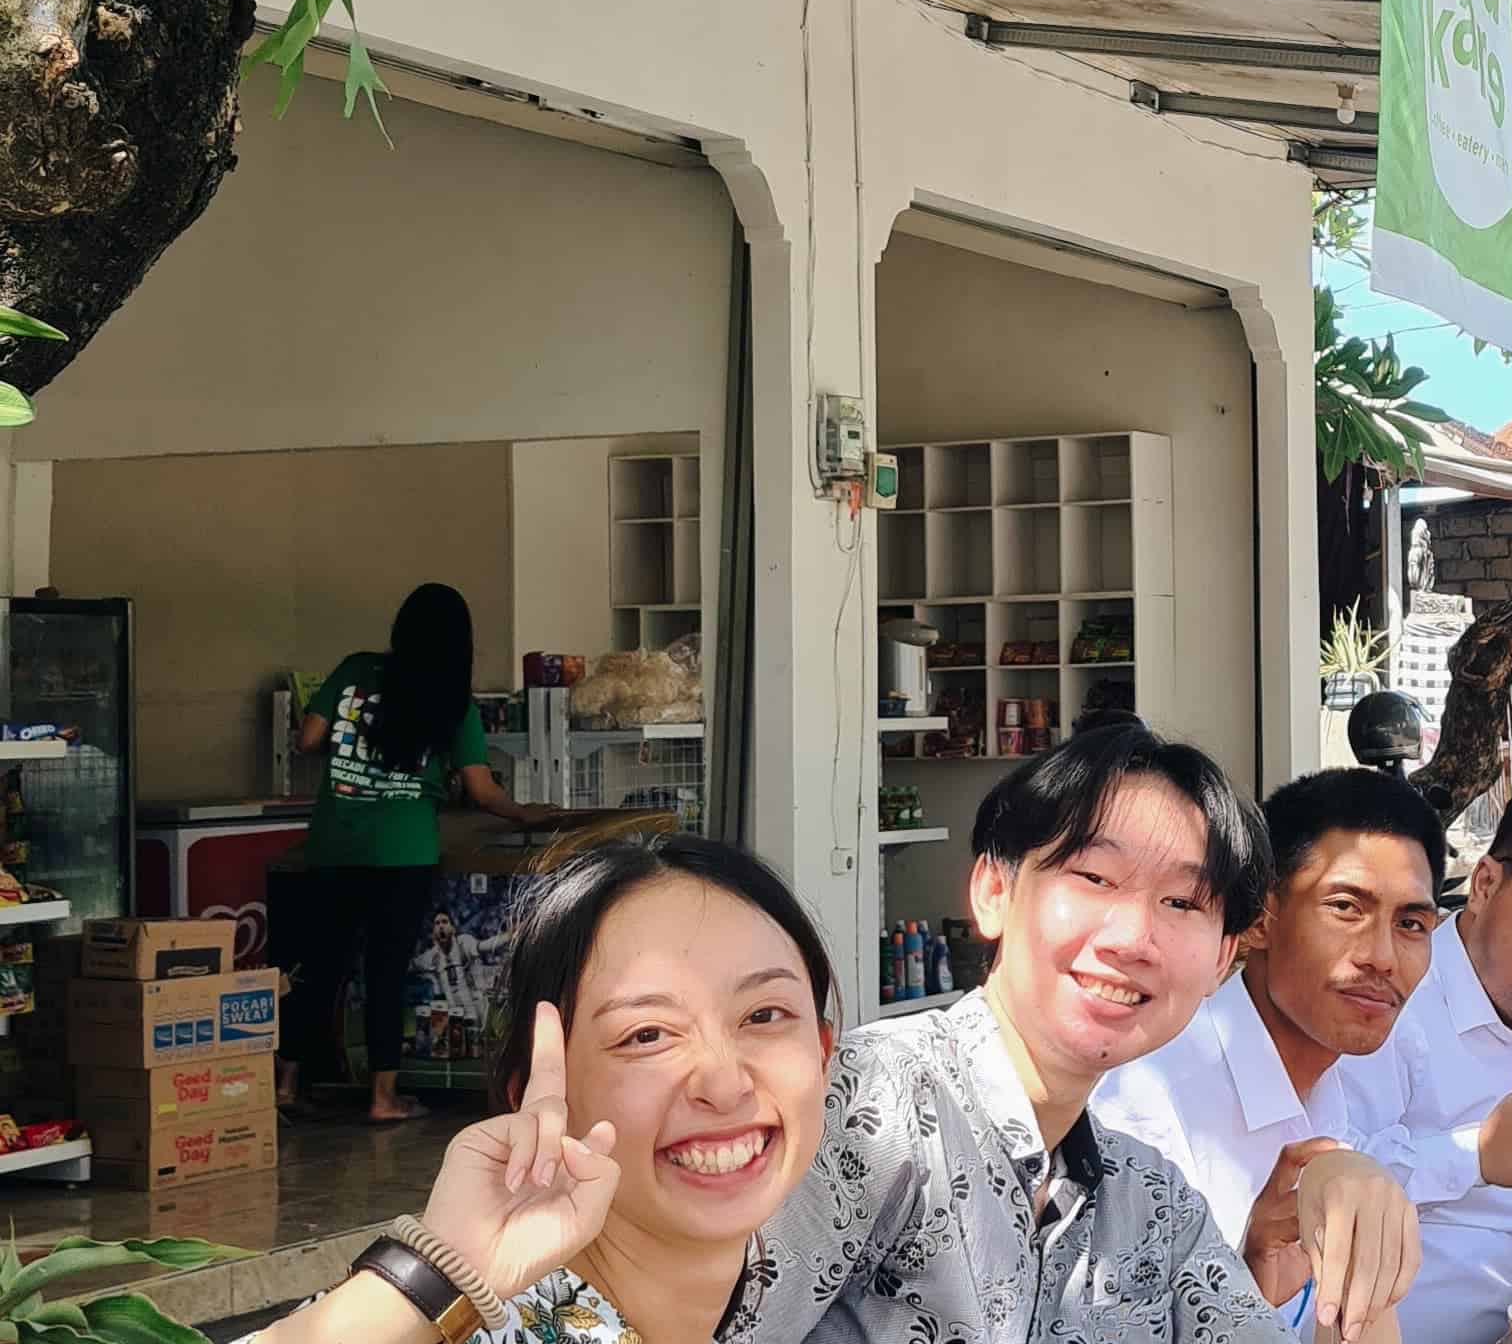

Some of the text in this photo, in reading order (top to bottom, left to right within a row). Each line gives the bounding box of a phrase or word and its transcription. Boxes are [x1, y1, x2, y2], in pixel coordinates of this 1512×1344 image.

[222, 997, 274, 1012] POCARI
[222, 1010, 268, 1025] SWEAT
[177, 1087, 209, 1103] Day
[180, 1149, 209, 1164] Day
